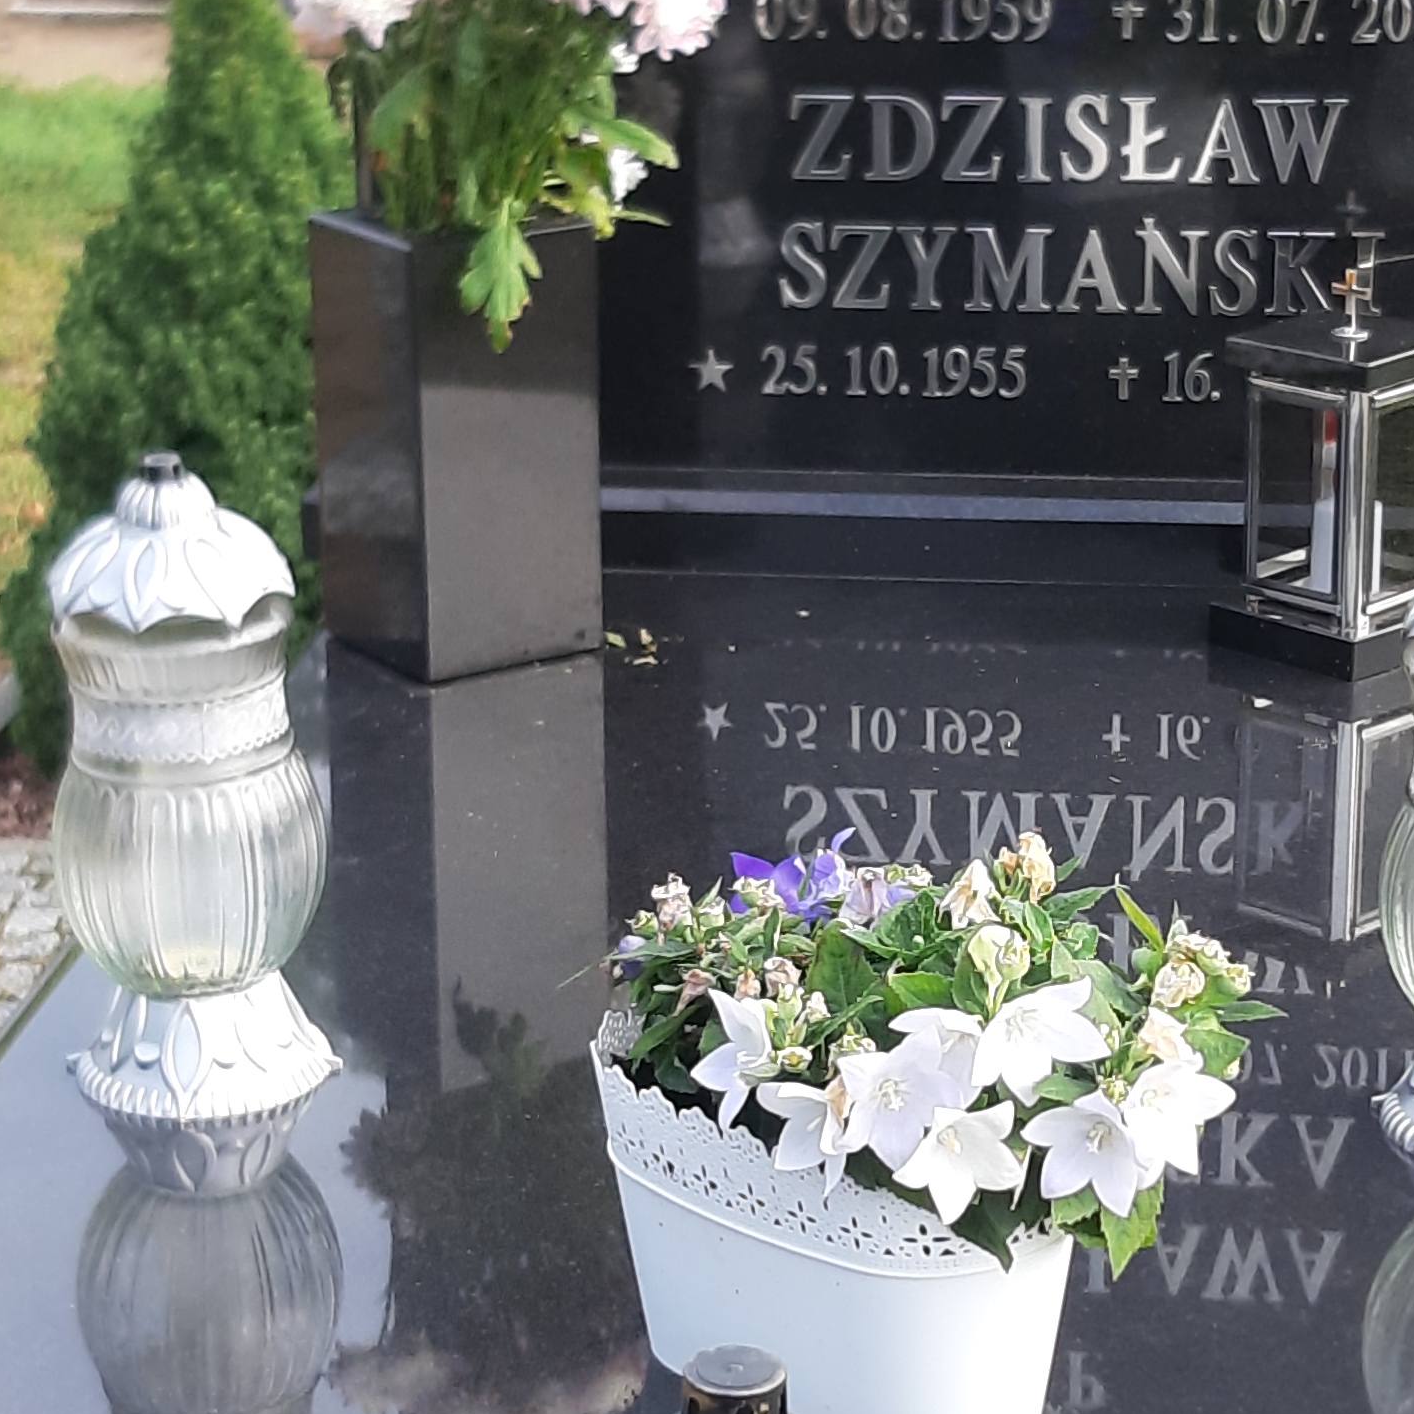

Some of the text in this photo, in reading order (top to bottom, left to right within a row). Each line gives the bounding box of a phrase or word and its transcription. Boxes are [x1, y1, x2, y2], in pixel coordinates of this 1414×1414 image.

[789, 94, 1350, 184] ZDZISŁAW
[779, 217, 1385, 316] SZYMAŃSKI
[1162, 351, 1220, 402] 16.
